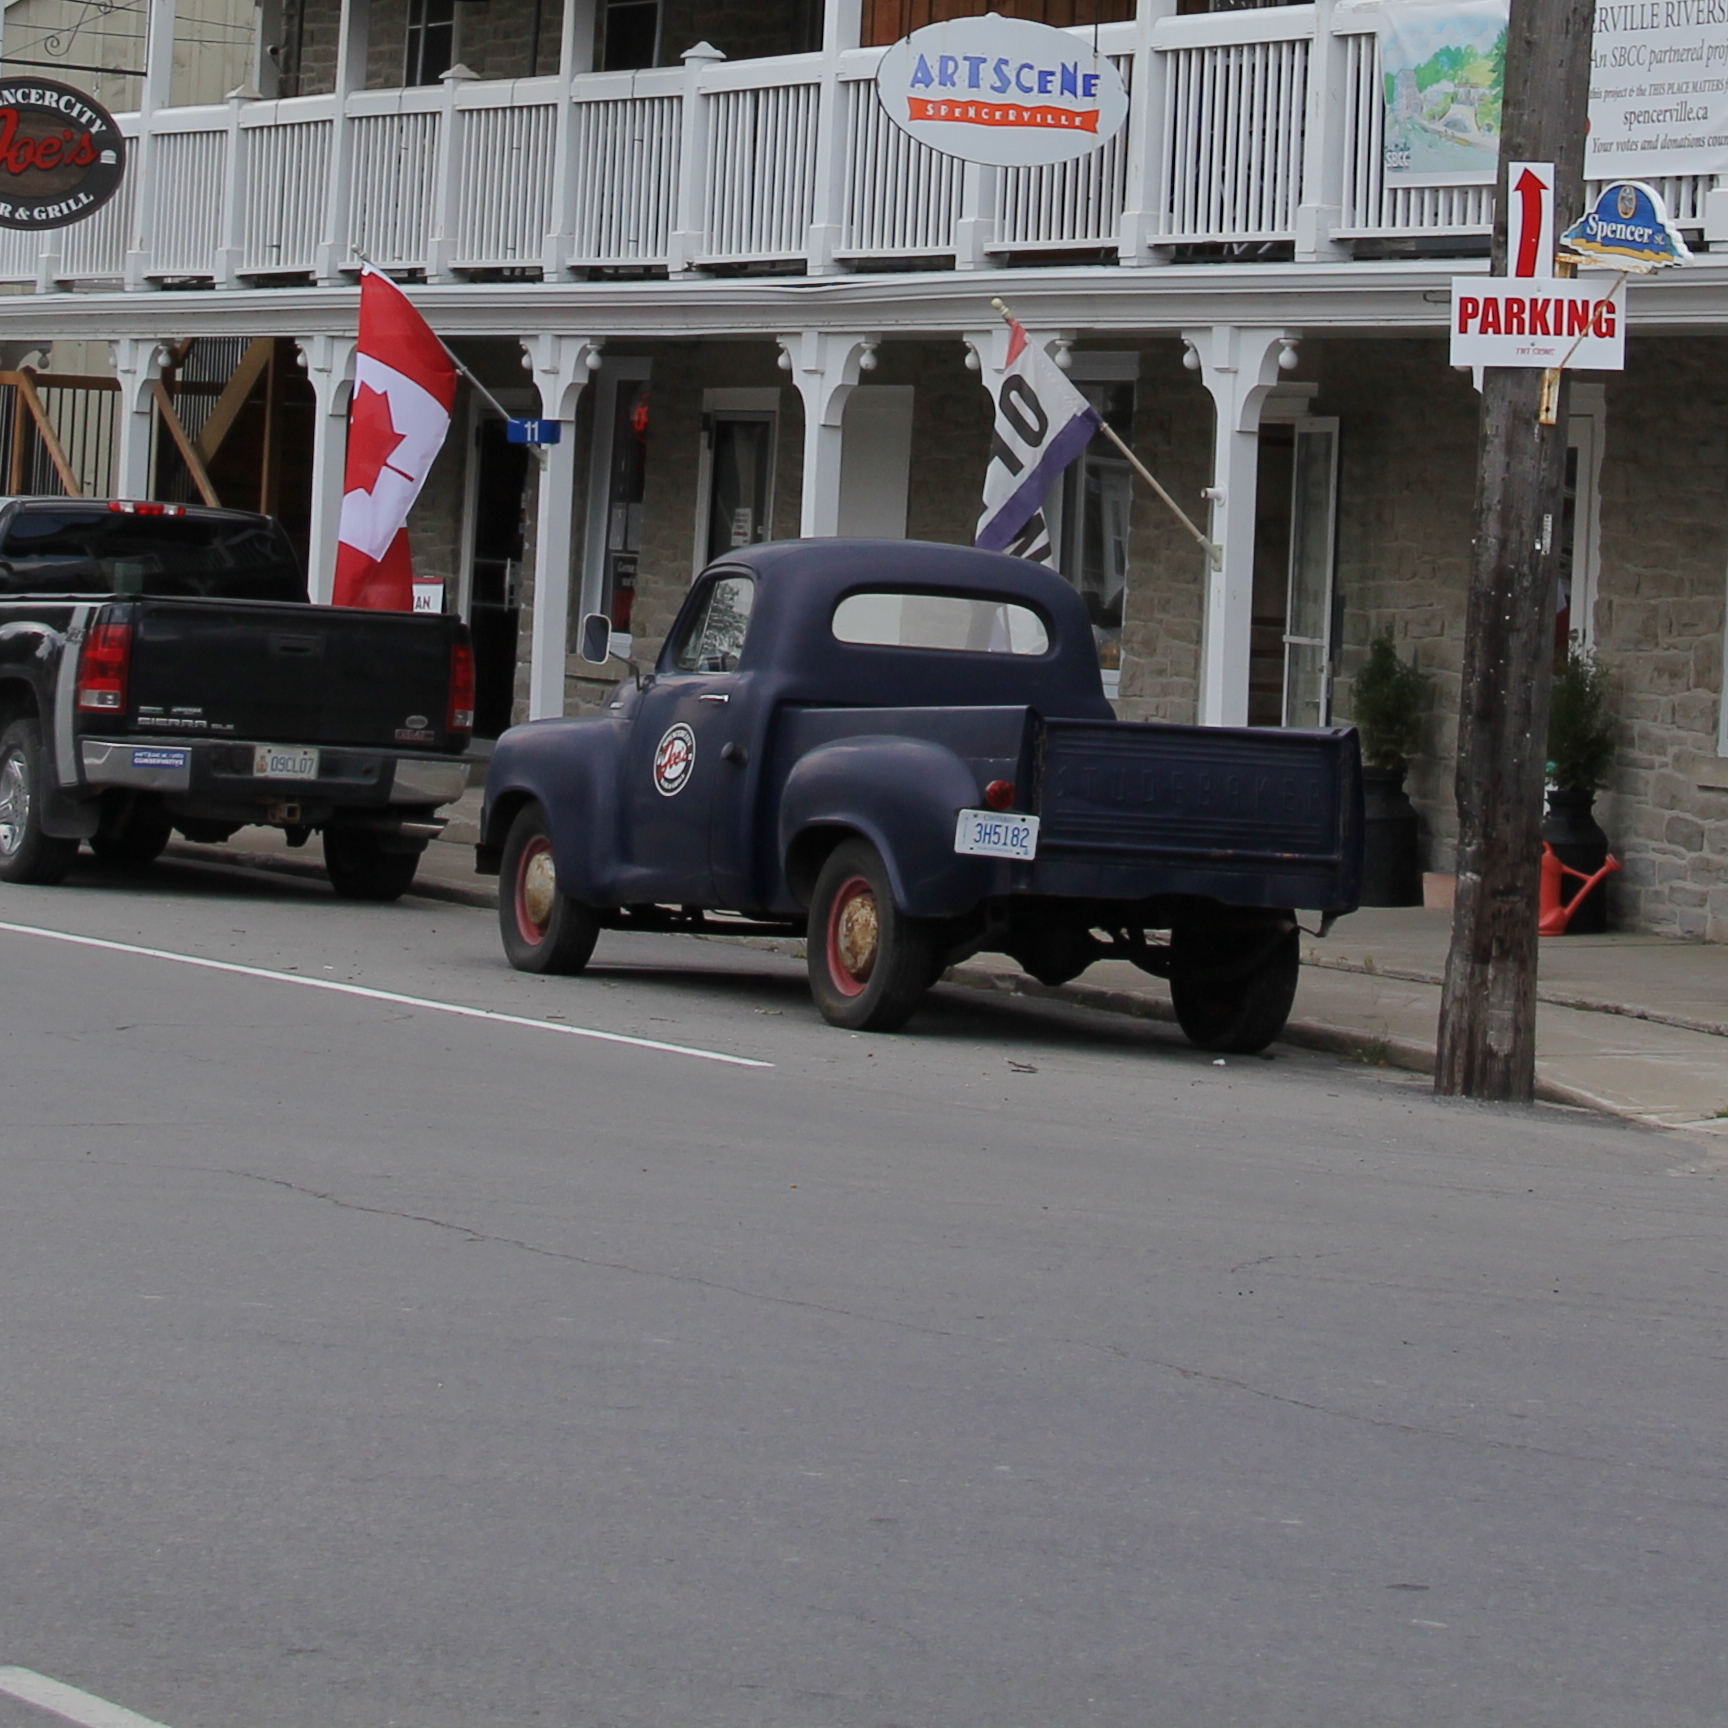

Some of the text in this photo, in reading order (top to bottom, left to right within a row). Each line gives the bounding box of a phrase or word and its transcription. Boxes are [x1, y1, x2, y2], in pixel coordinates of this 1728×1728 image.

[1610, 44, 1648, 68] SBCC
[1647, 39, 1704, 72] partnered
[1603, 86, 1627, 102] project
[1636, 84, 1647, 97] the
[1649, 83, 1666, 97] THIS
[1667, 80, 1690, 95] PLACE
[1692, 77, 1724, 93] MATTERS
[925, 104, 1083, 126] SPENCERVILLE
[1622, 100, 1708, 131] spencerville.ca
[1591, 137, 1614, 153] Your
[1616, 137, 1639, 152] votes
[1640, 133, 1659, 150] and
[1660, 132, 1706, 149] donations
[15, 206, 31, 220] &
[33, 191, 95, 220] GRILL
[1586, 213, 1652, 242] Spencer
[1458, 297, 1616, 338] PARKING
[524, 421, 539, 442] 11
[137, 717, 208, 728] SIERRA
[973, 822, 1030, 849] 3H5182
